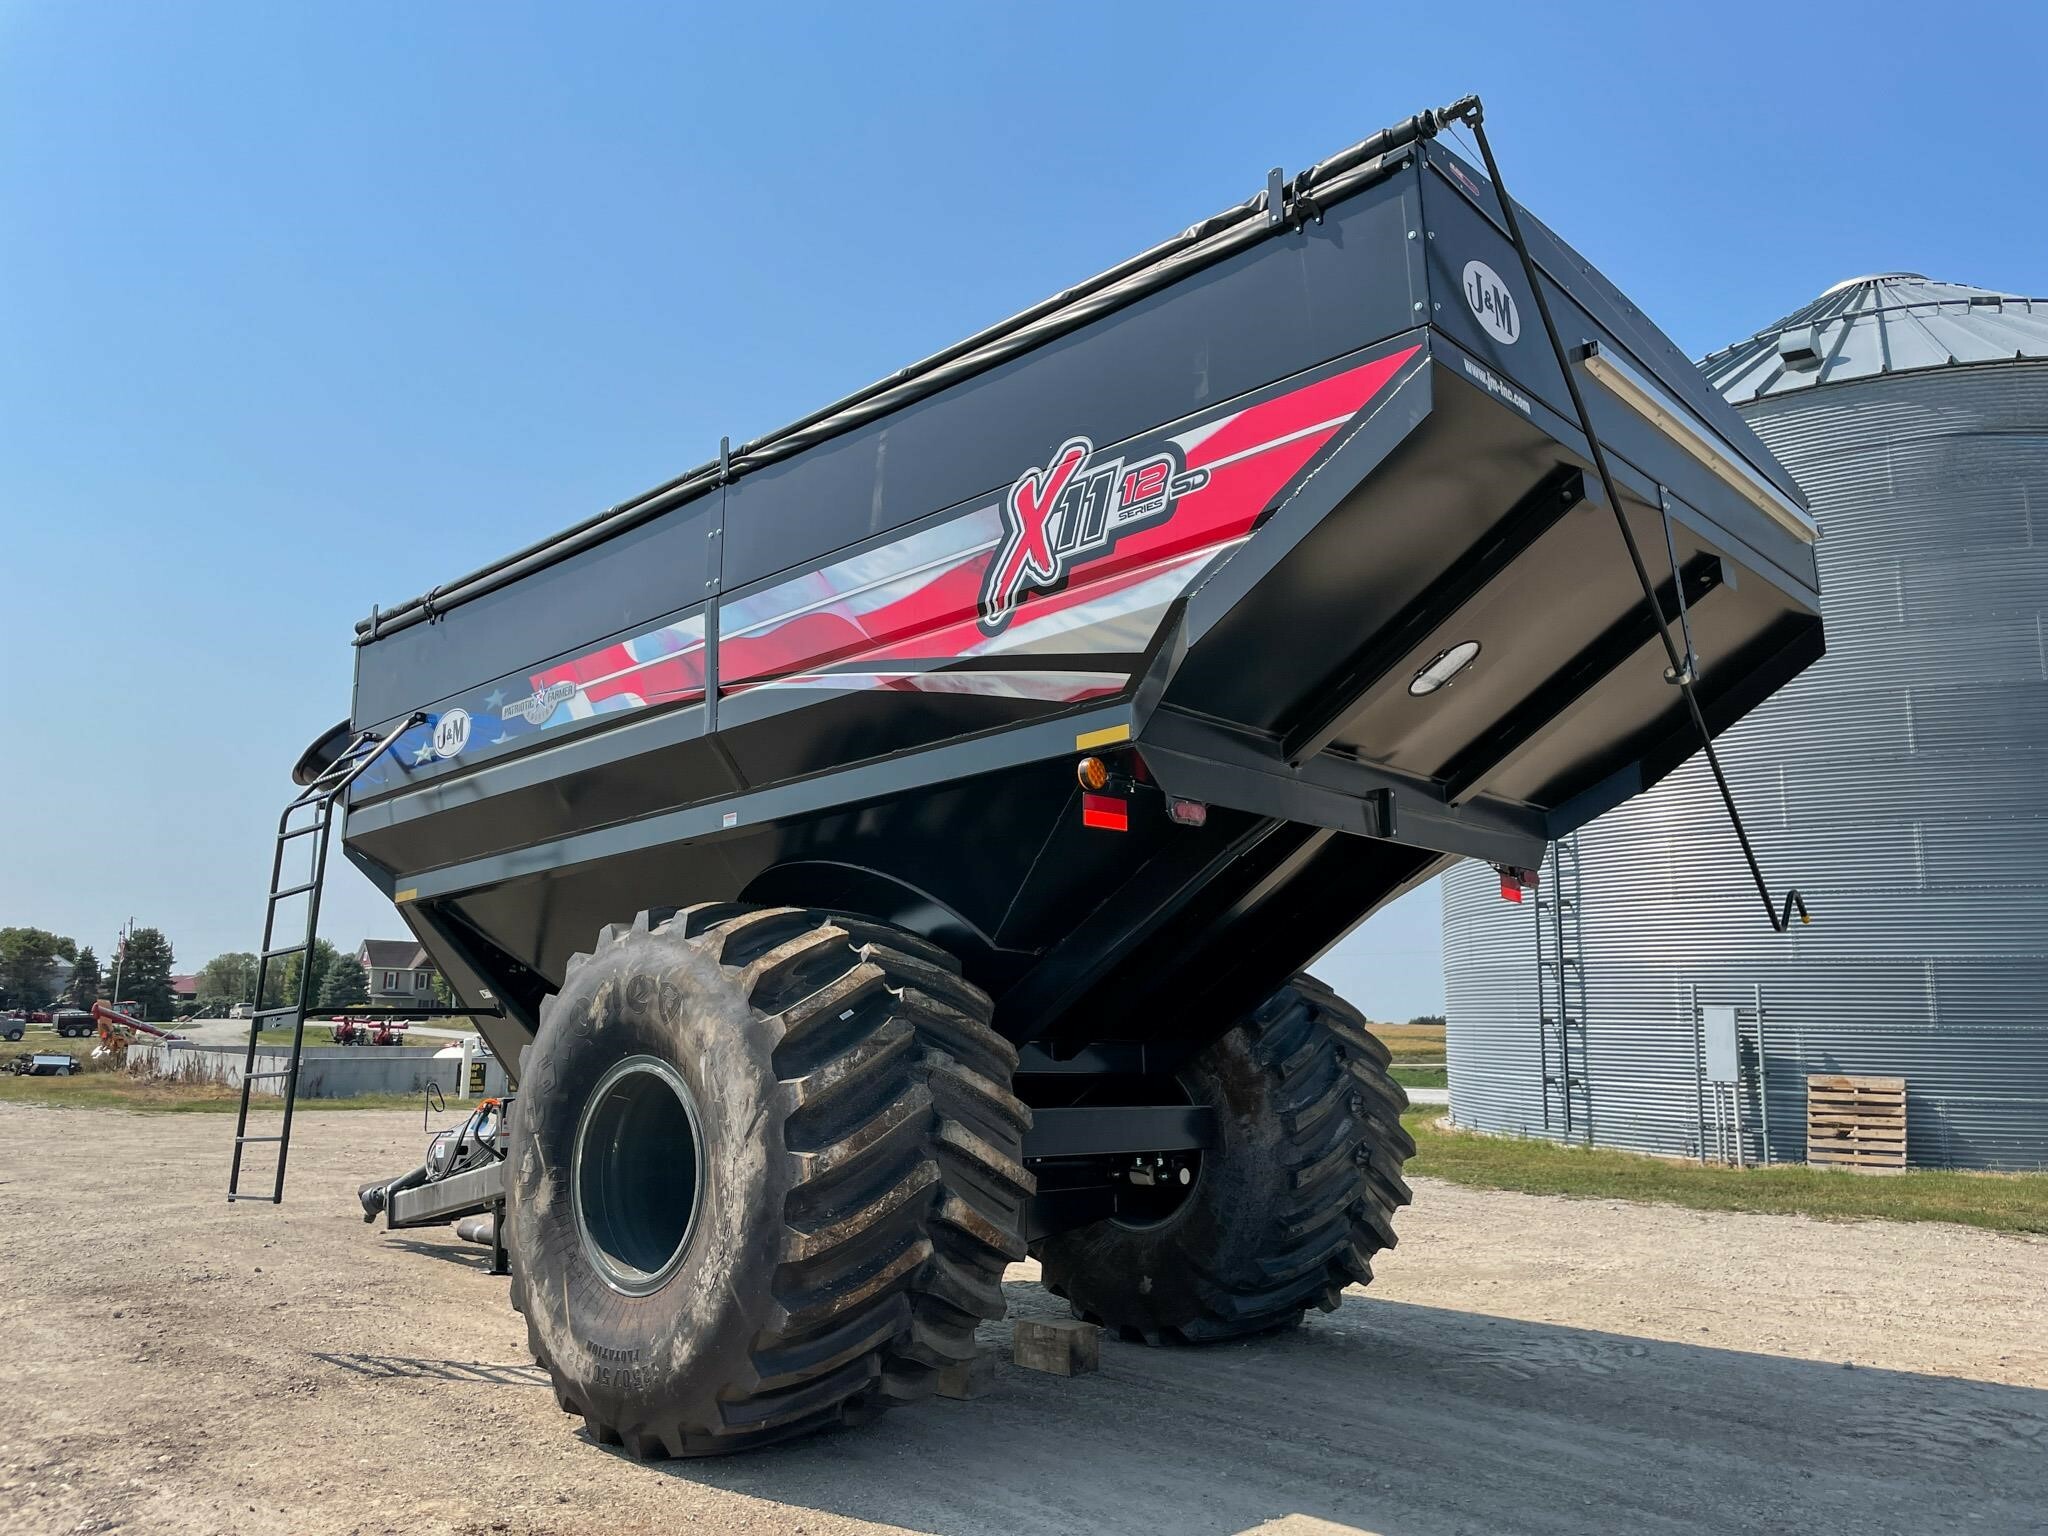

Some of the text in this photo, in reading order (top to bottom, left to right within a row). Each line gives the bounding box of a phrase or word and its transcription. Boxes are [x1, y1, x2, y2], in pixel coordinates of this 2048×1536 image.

[1467, 270, 1515, 338] J&M
[1463, 357, 1532, 416] www.jm-inc.com
[985, 438, 1211, 622] X11 12 SD
[1118, 499, 1164, 522] SERIES
[503, 699, 536, 718] PATRIOTIC
[436, 715, 465, 750] J&M
